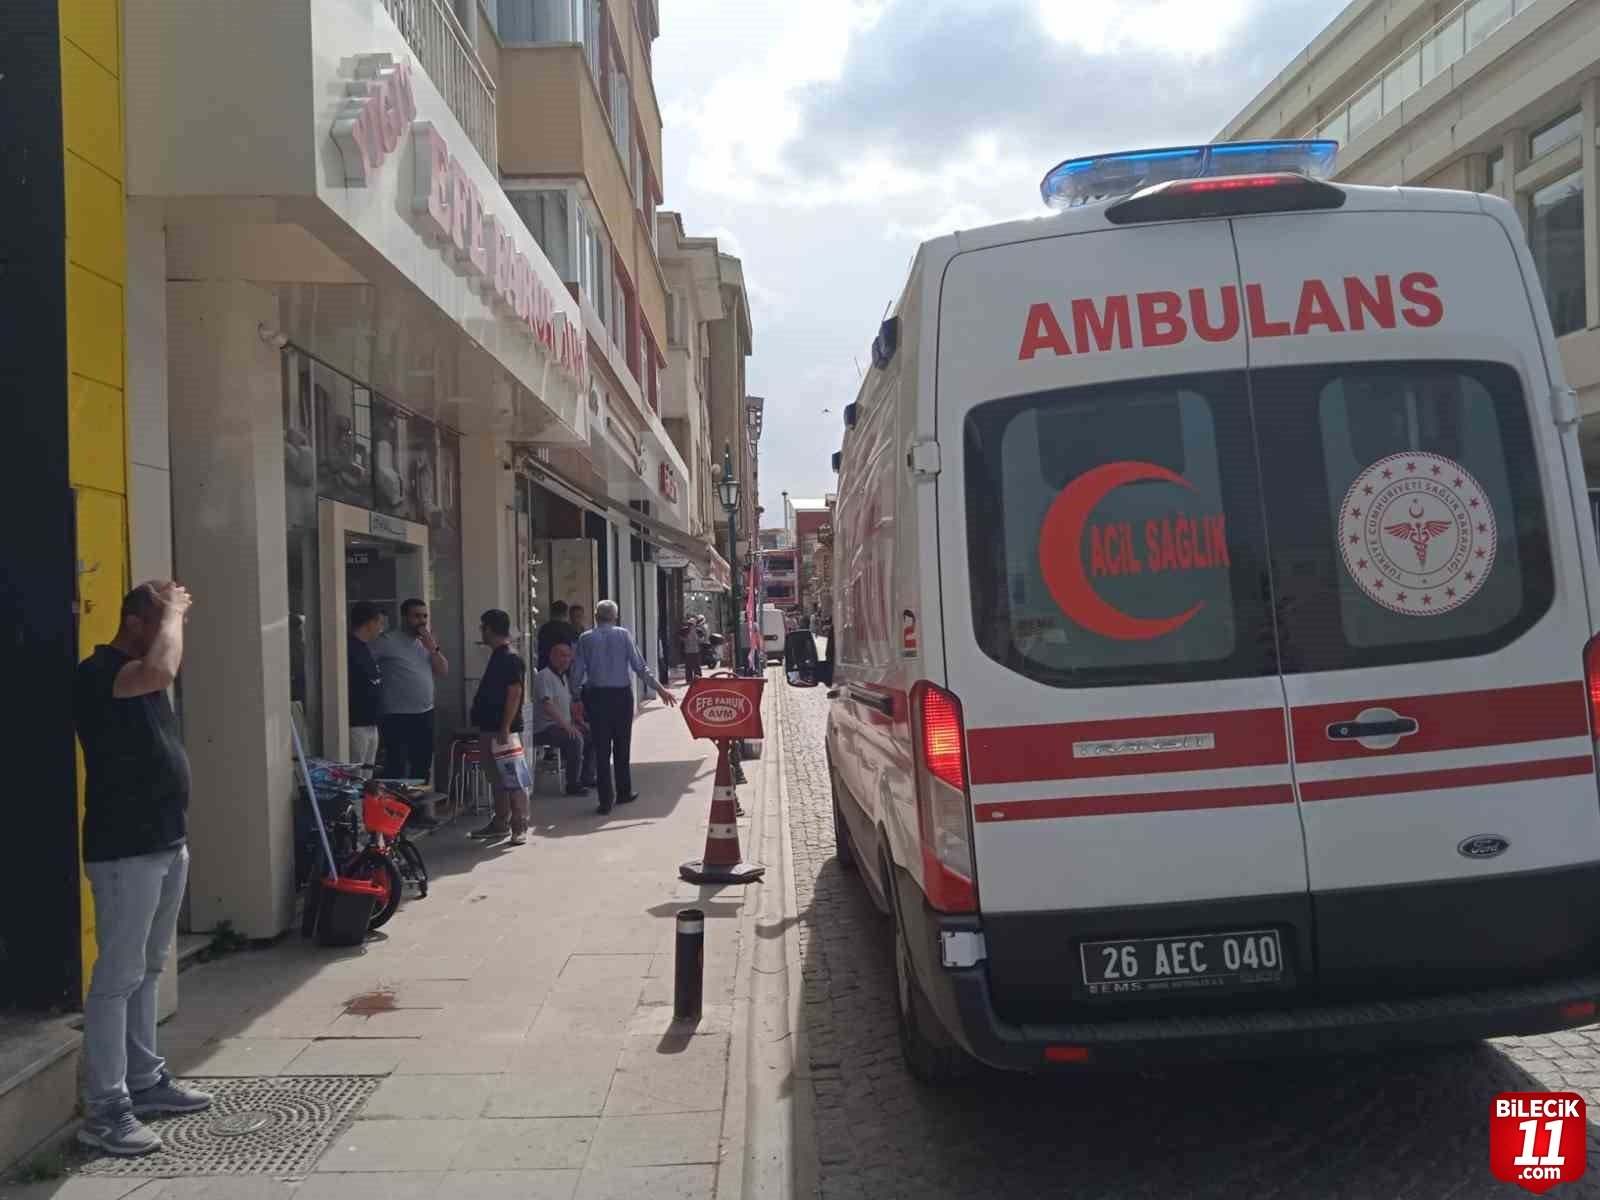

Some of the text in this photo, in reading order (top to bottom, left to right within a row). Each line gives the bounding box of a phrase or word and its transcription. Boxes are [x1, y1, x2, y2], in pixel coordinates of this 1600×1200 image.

[1018, 271, 1444, 361] AMBULANS
[1145, 511, 1231, 574] SAĞLIK
[696, 697, 745, 713] EFE FARUK
[708, 709, 733, 719] AVM
[1102, 936, 1277, 979] 26 AEC 040
